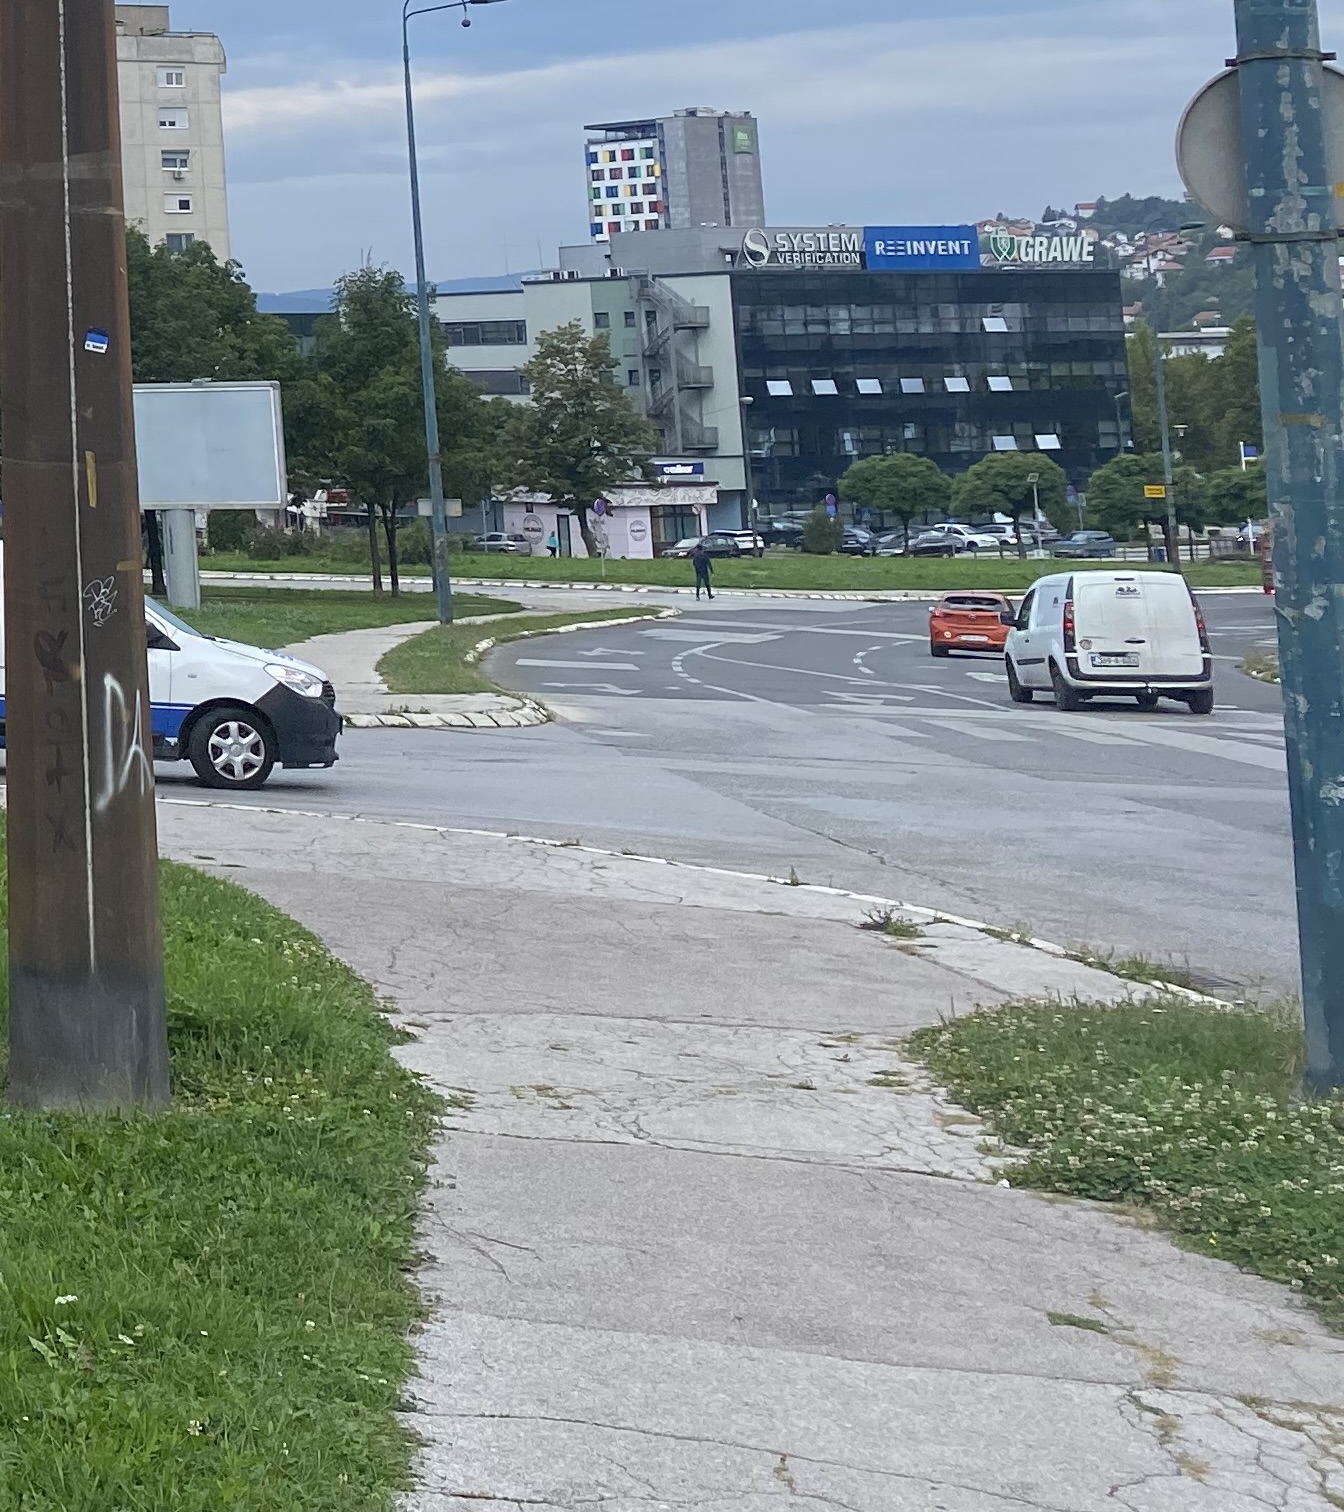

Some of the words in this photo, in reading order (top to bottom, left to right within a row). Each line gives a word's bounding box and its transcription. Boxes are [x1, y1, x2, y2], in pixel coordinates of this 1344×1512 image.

[776, 232, 859, 251] SYSTEM
[1020, 235, 1095, 263] GRAWE
[776, 250, 861, 265] VERIFICATION
